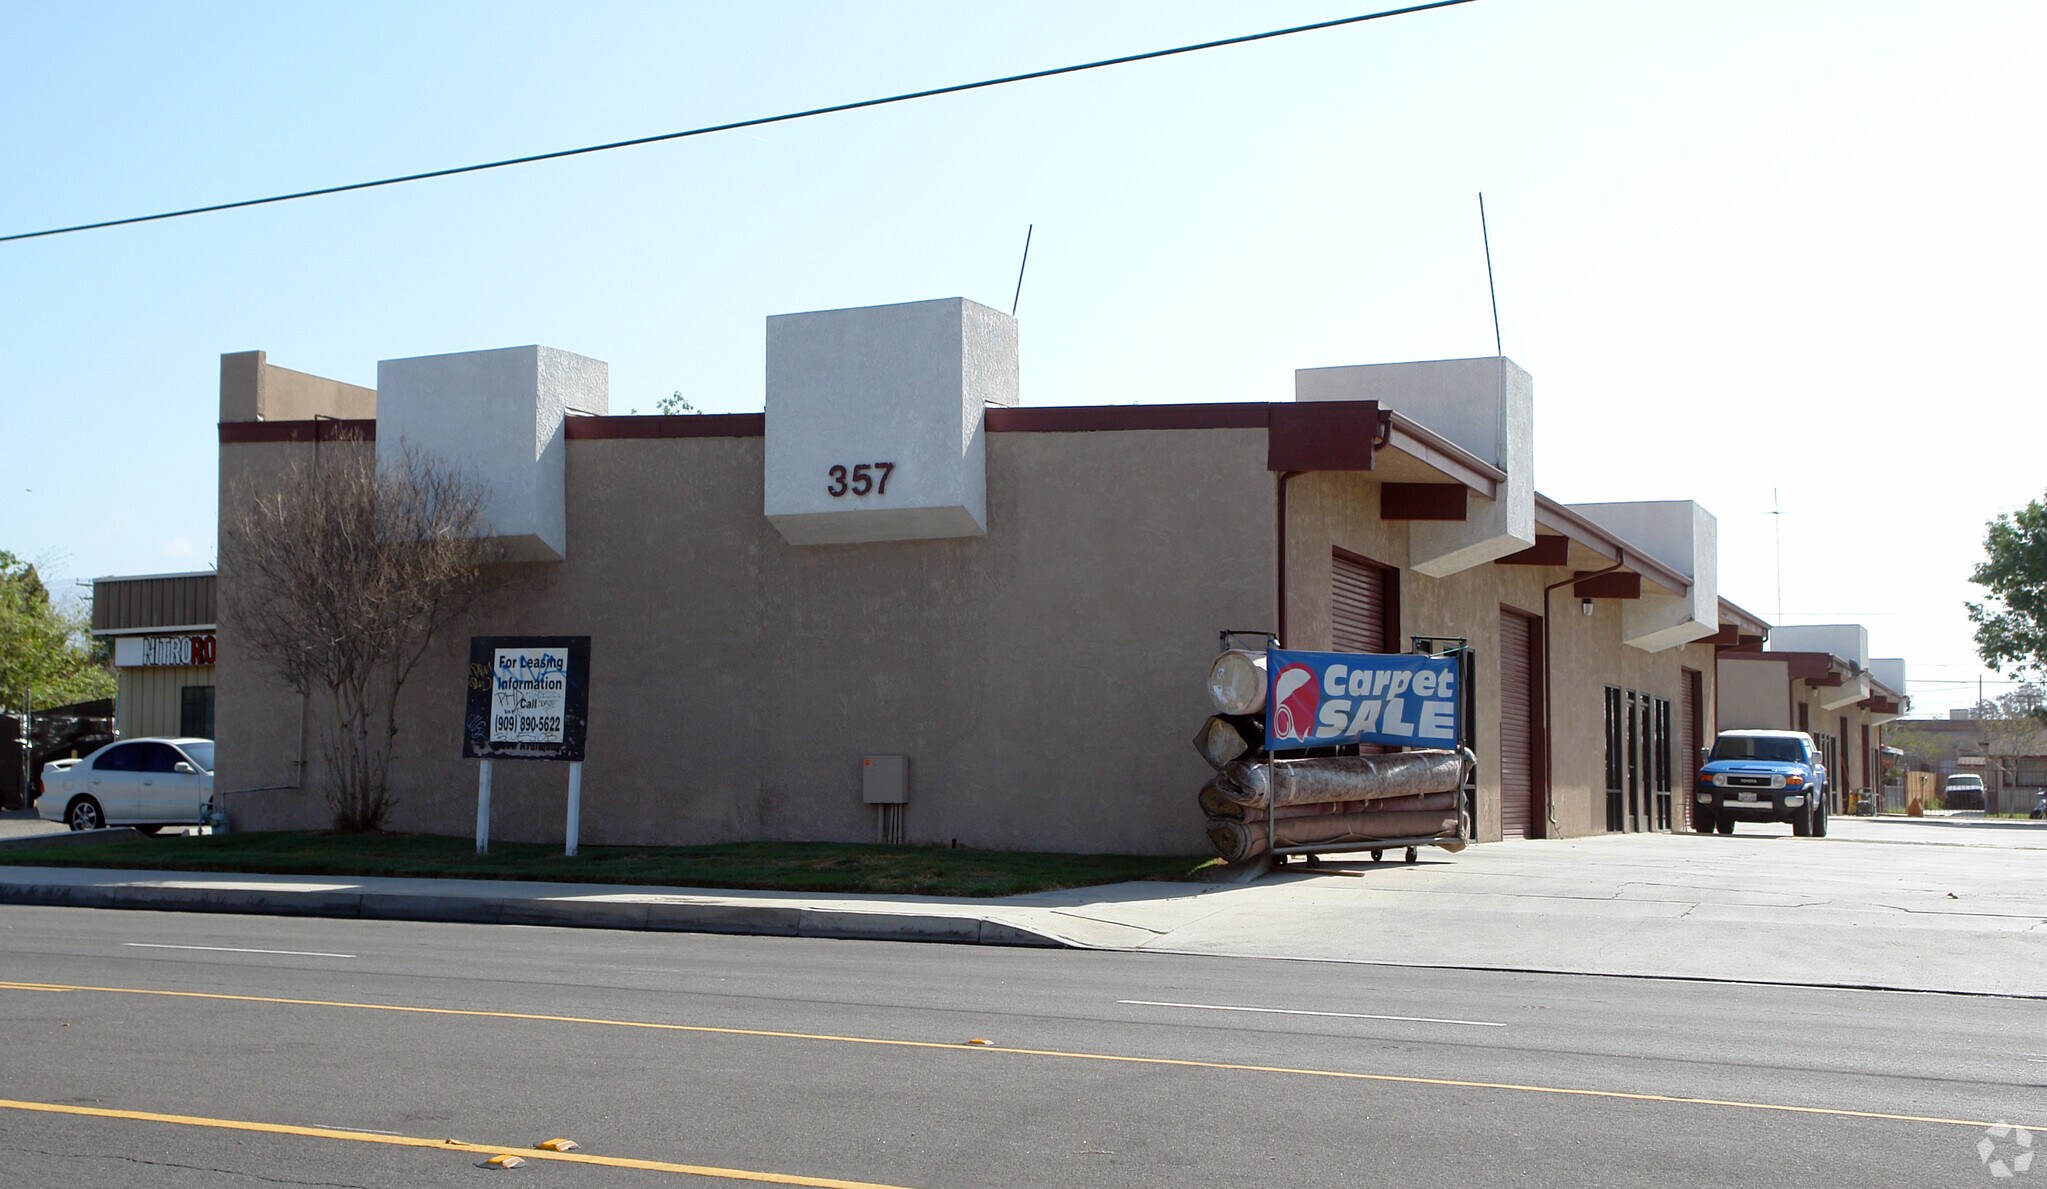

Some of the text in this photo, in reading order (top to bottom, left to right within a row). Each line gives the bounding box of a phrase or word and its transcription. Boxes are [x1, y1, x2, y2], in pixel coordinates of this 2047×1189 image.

[828, 462, 894, 498] 357
[499, 656, 564, 671] For Leasing
[497, 677, 562, 690] Information
[1323, 664, 1455, 700] Carpet
[520, 698, 537, 709] Call
[495, 714, 518, 733] (909)
[520, 716, 560, 732] 890-5622
[1315, 699, 1454, 740] SALE
